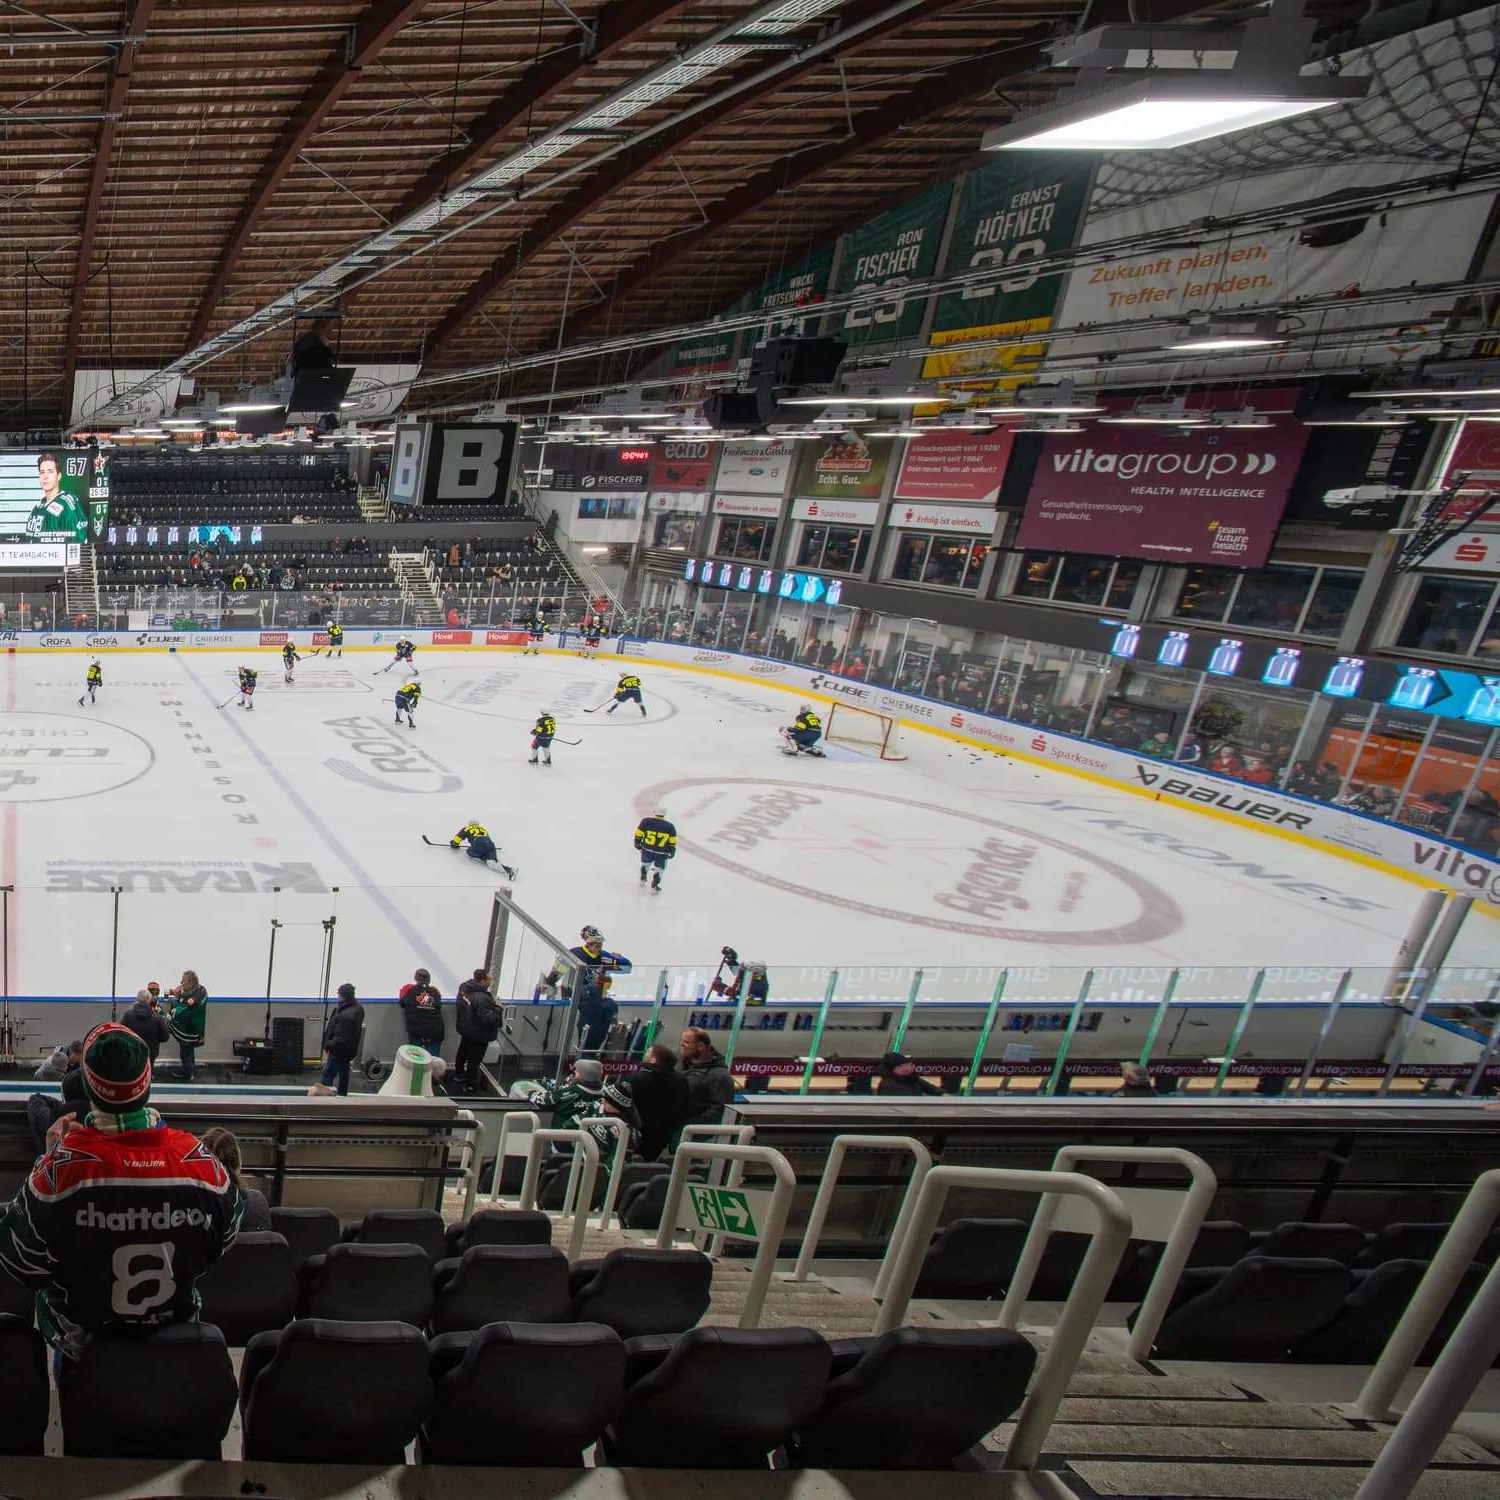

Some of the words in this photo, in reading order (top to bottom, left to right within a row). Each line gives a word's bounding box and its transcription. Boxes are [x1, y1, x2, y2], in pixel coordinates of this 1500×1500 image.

[1011, 184, 1062, 209] ERNST
[974, 202, 1055, 246] HÖFNER
[897, 229, 924, 247] RON
[854, 245, 921, 281] FISCHER
[1088, 257, 1172, 285] Zukunft
[1177, 244, 1269, 274] planen,
[1107, 287, 1176, 307] Treffer
[1182, 272, 1274, 300] landen.
[665, 441, 709, 459] echo
[66, 457, 87, 476] 67
[437, 429, 504, 499] B
[1052, 449, 1237, 480] vitagroup
[597, 475, 643, 483] FISCHER
[817, 474, 838, 485] Echt.
[841, 474, 861, 486] Gut.
[90, 488, 108, 497] 25:54
[1131, 487, 1174, 497] HEALTH
[1180, 487, 1266, 499] INTELLIGENCE
[1042, 499, 1144, 514] Gesundheitsversorgung
[916, 515, 938, 526] Erfolg
[940, 517, 950, 526] ist
[952, 518, 982, 528] einfach.
[1038, 511, 1053, 520] neu
[1056, 511, 1092, 522] gedacht.
[1207, 520, 1246, 535] #team
[1214, 533, 1249, 543] future
[1211, 542, 1248, 551] health
[9, 551, 60, 560] TEAMSACHE
[46, 637, 72, 646] ROFA
[92, 637, 118, 646] ROFA
[148, 635, 186, 643] CUBE
[196, 635, 233, 643] CHIEMSEE
[261, 633, 288, 643] komro
[488, 632, 509, 641] Hoval
[823, 680, 870, 700] CUBE
[881, 696, 934, 718] CHIEMSEE
[966, 723, 1016, 745] Sparkasse
[323, 716, 433, 773] ROFA
[1051, 746, 1108, 771] Sparkasse
[644, 829, 669, 846] 57
[46, 861, 330, 896] KRAUSE
[734, 1062, 794, 1075] vitagroup
[982, 1063, 1042, 1076] vitagroup
[1147, 1064, 1208, 1077] vitagroup
[1230, 1064, 1292, 1077] vitagroup
[1314, 1065, 1374, 1077] vitagroup
[1400, 1066, 1462, 1077] vitagroup
